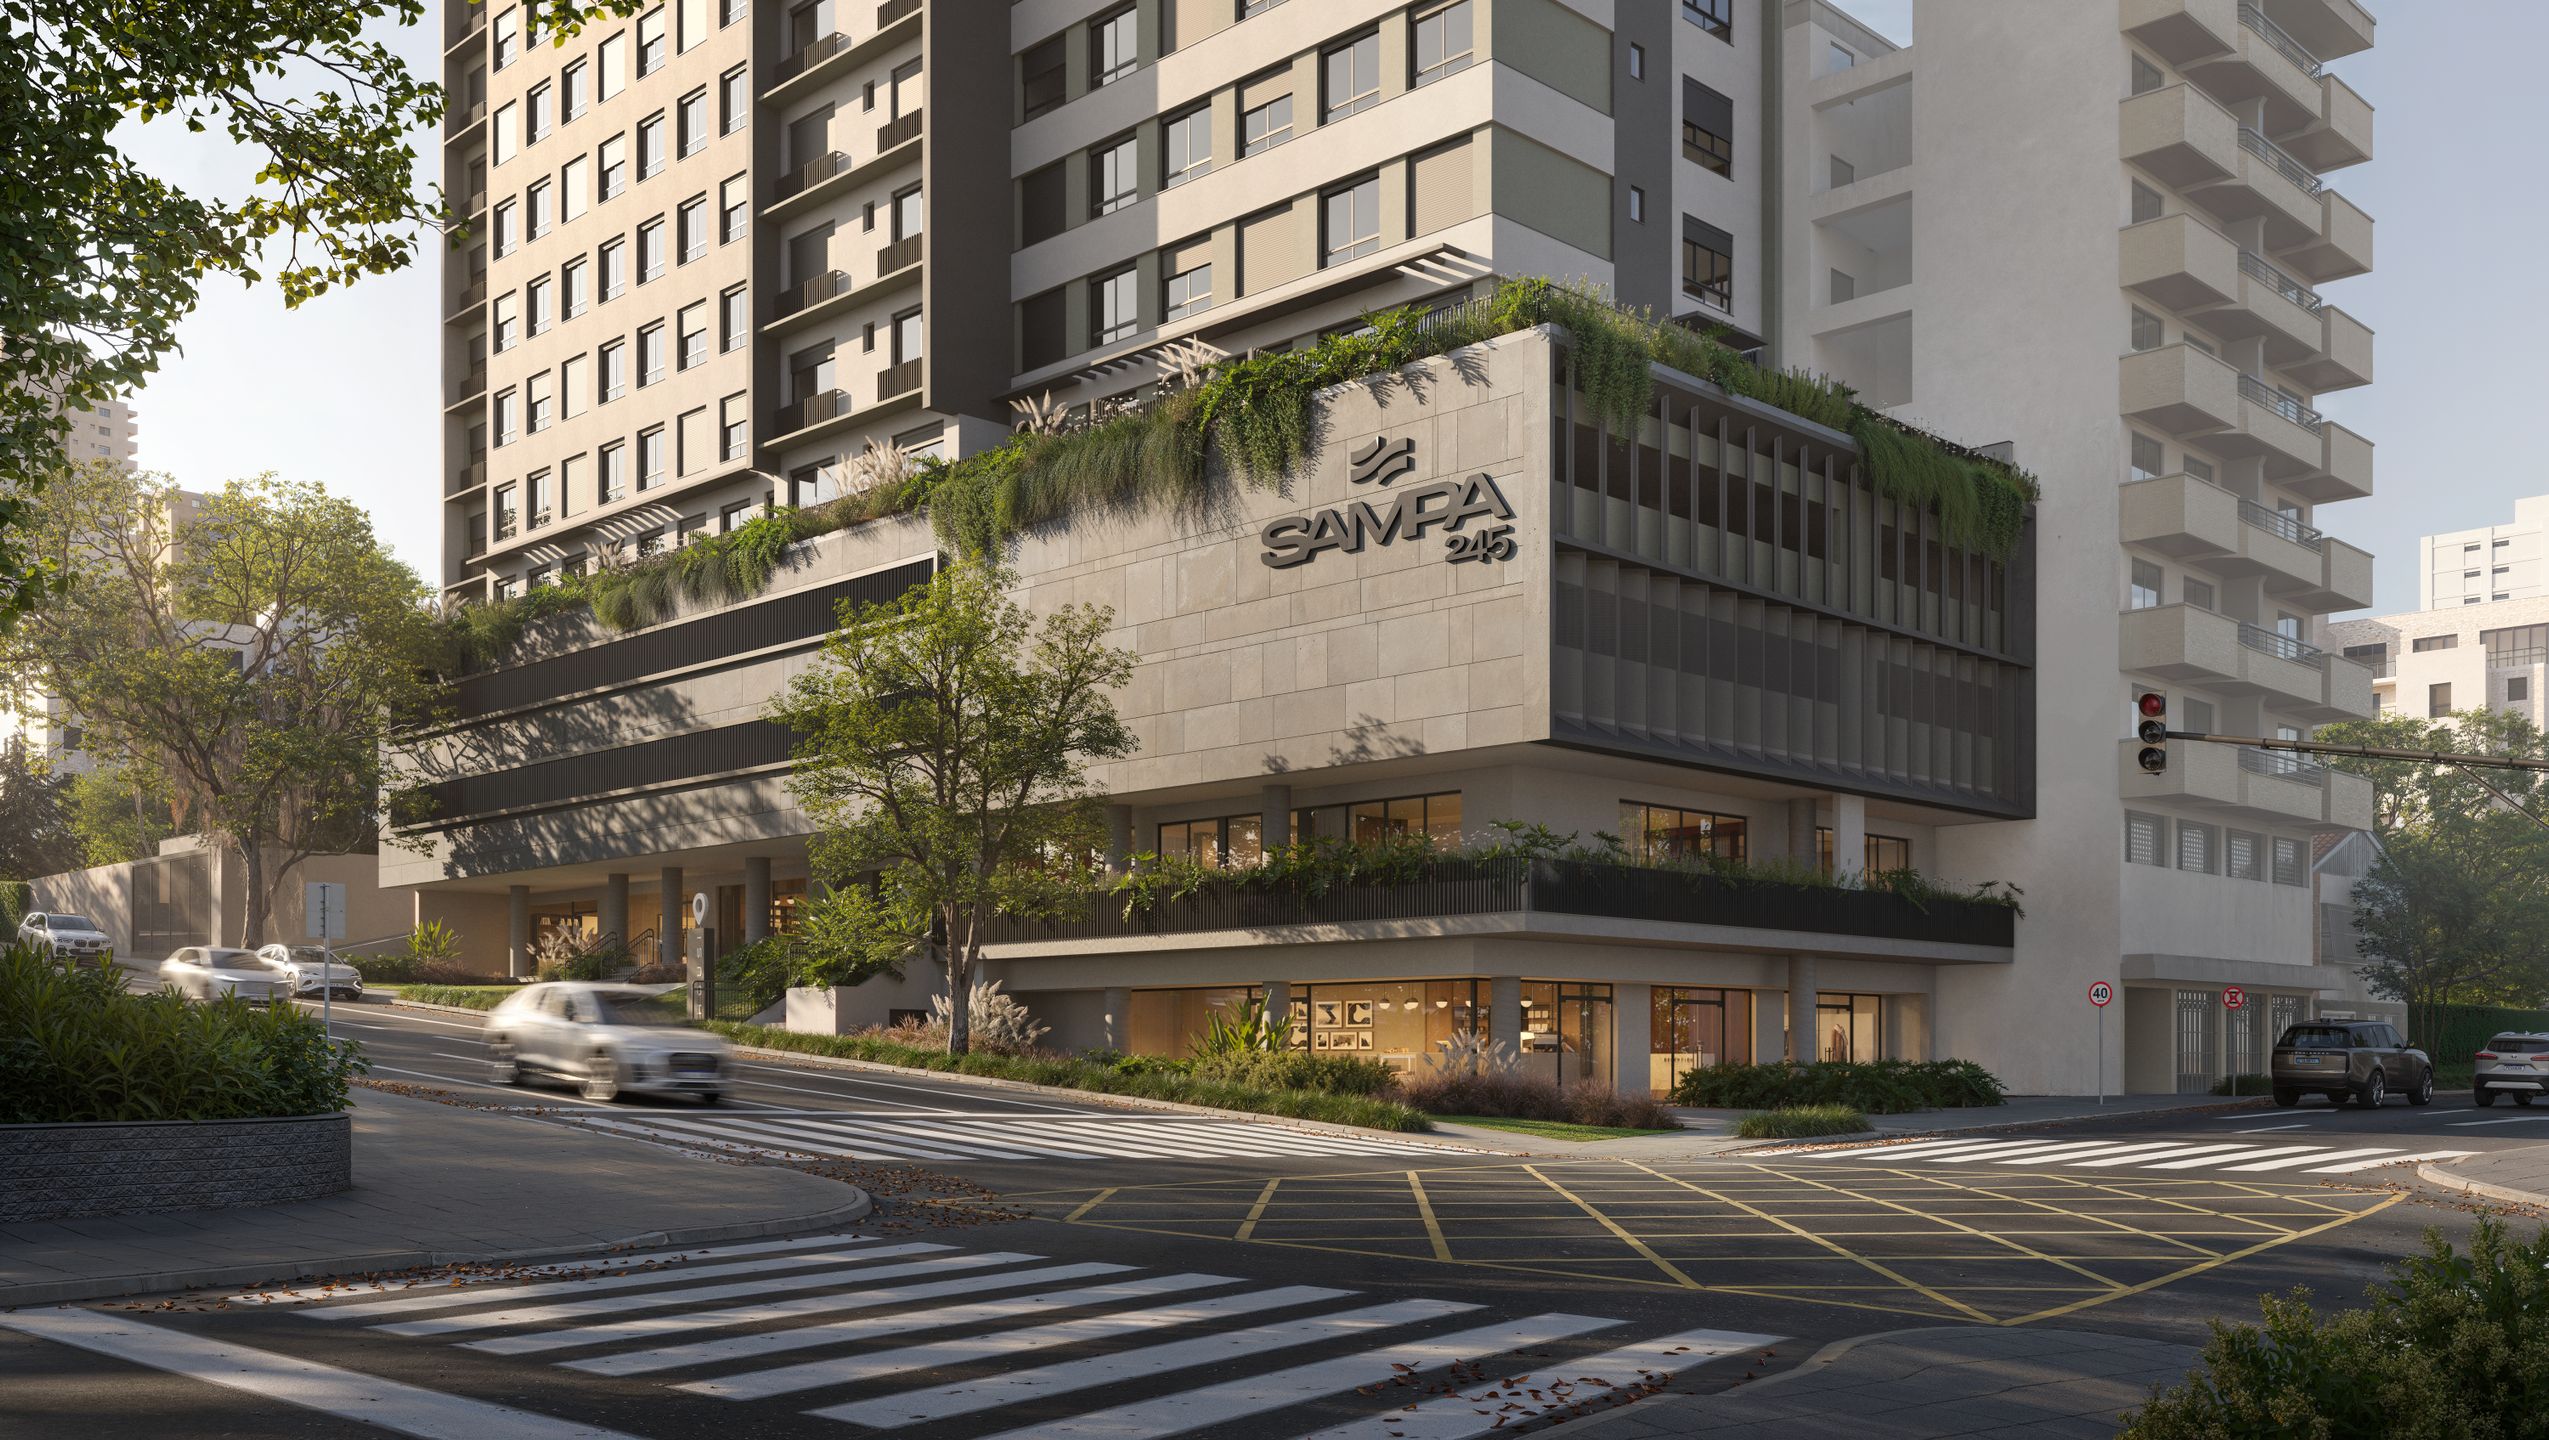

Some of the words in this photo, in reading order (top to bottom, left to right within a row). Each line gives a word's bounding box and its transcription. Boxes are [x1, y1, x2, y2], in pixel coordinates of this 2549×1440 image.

[1261, 472, 1514, 568] SAMPA
[1445, 524, 1515, 563] 245
[2093, 987, 2108, 999] 40
